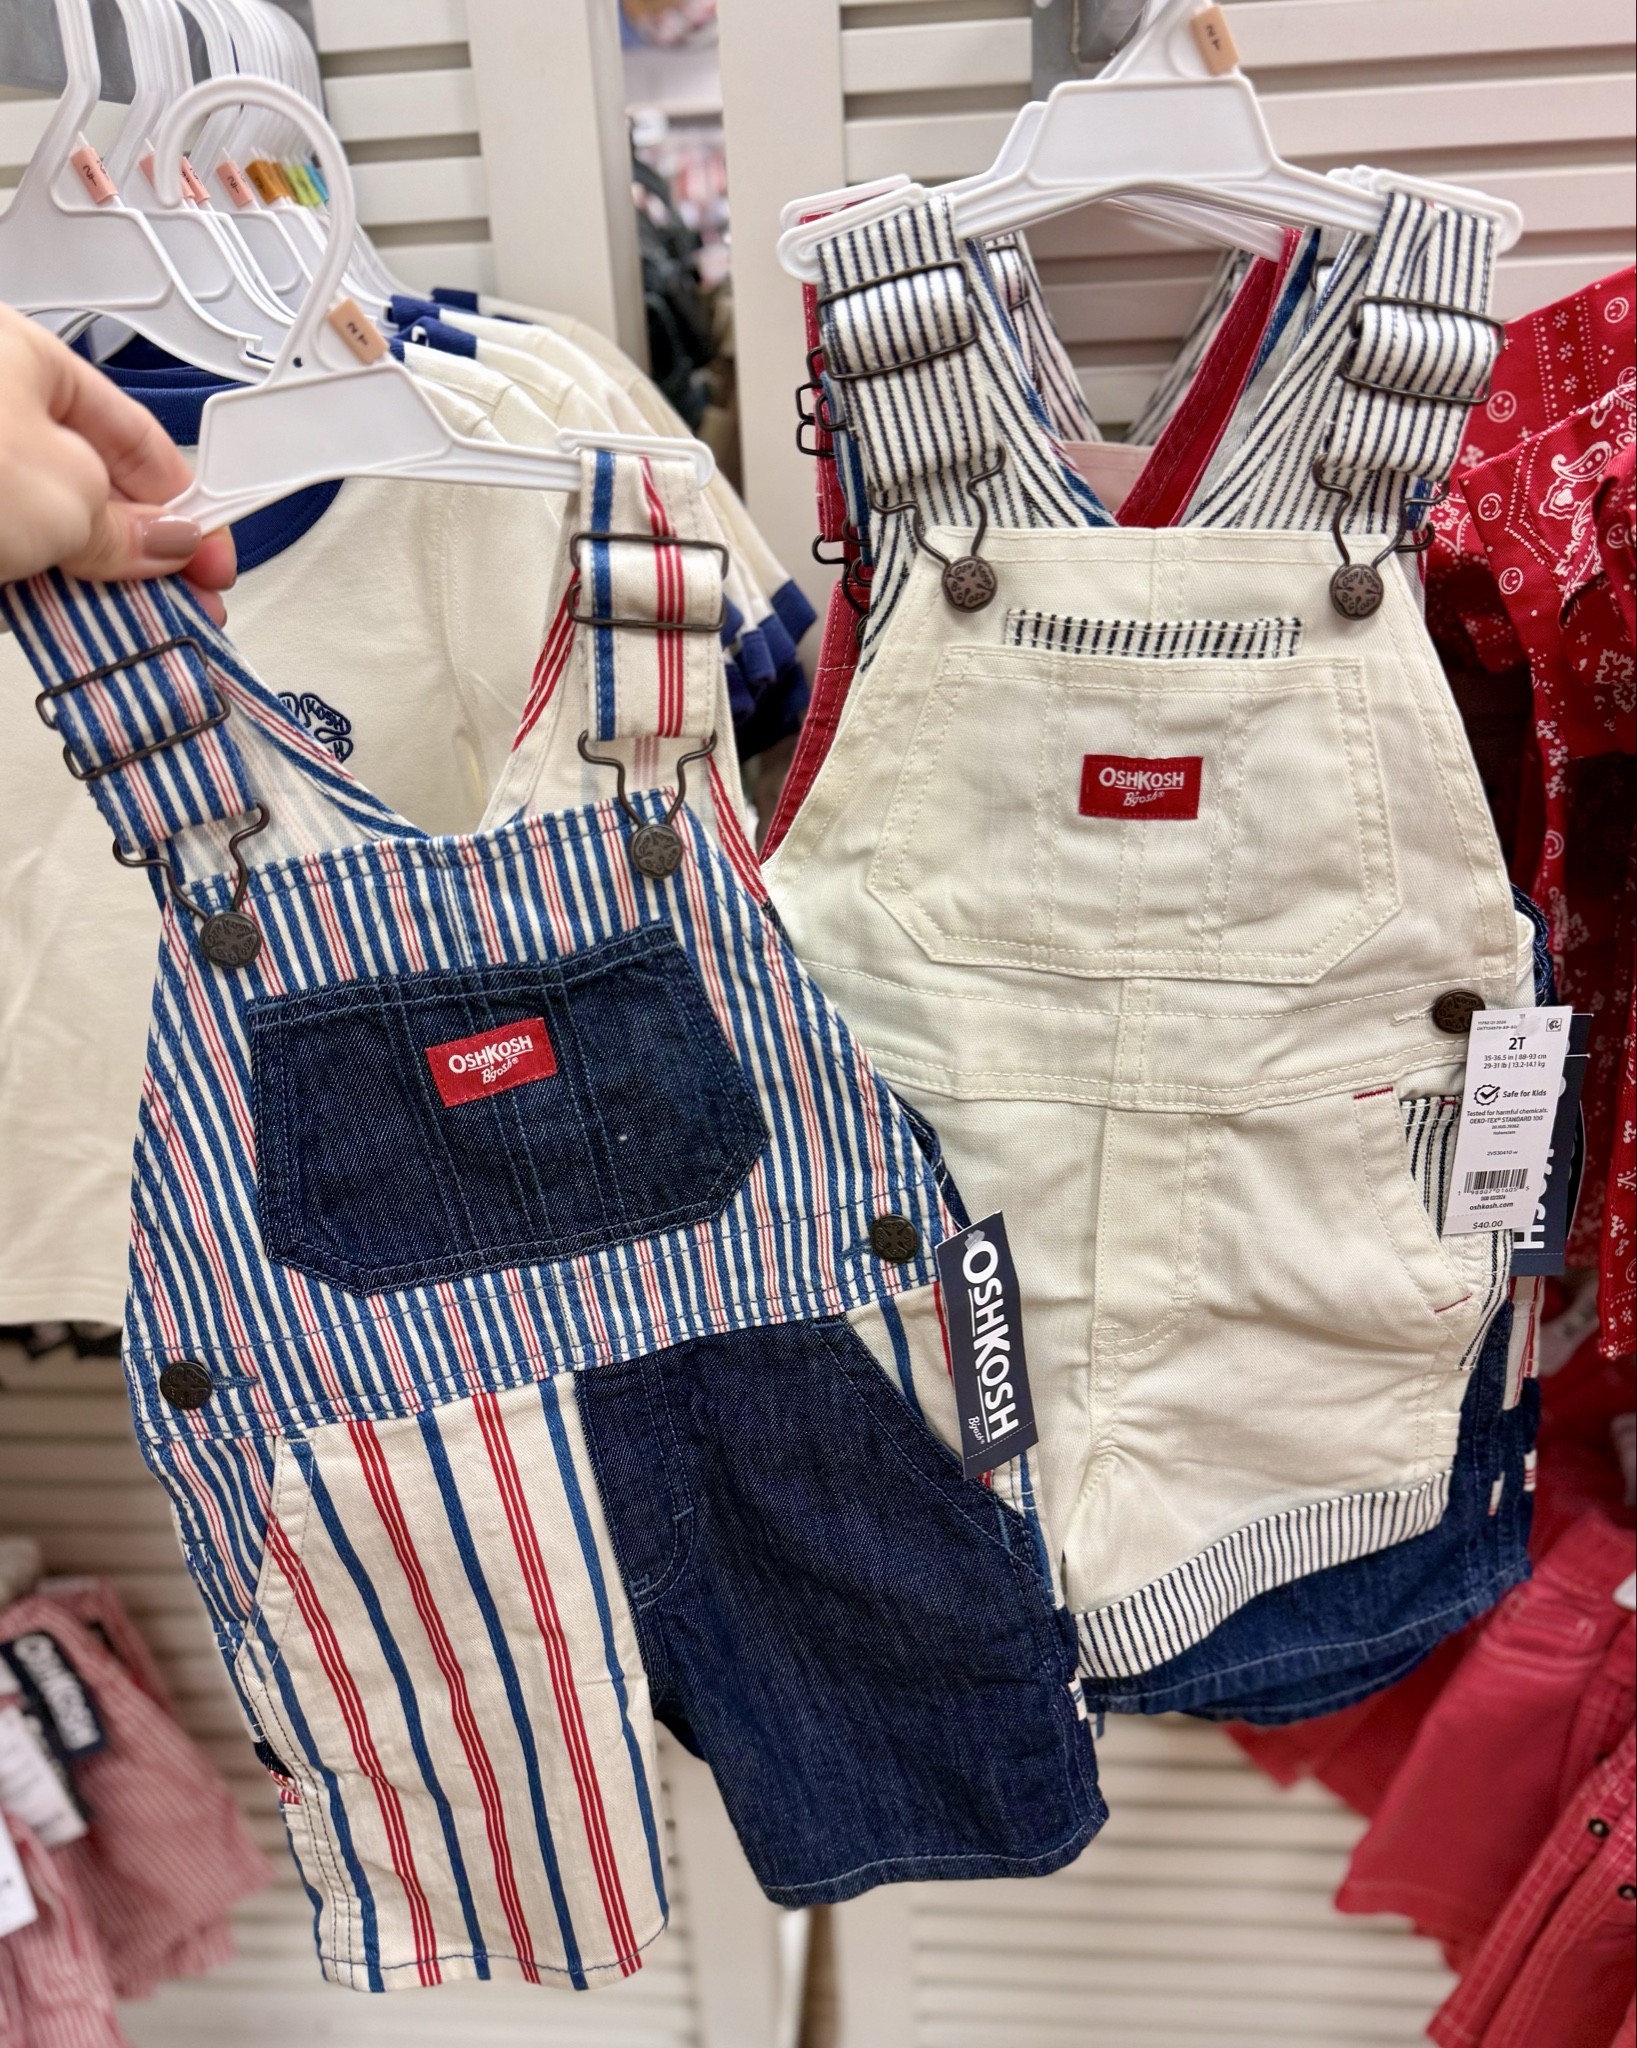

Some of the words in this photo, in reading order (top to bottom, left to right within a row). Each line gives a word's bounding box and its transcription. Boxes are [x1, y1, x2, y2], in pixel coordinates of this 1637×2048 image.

[1099, 767, 1185, 791] OSHKOSH
[1508, 1036, 1526, 1050] 2T
[448, 1035, 534, 1074] OSHKOSH
[1469, 1202, 1514, 1210] oshkosh.com
[1472, 1220, 1504, 1230] $40.00
[962, 1240, 1019, 1440] OSHKOSH
